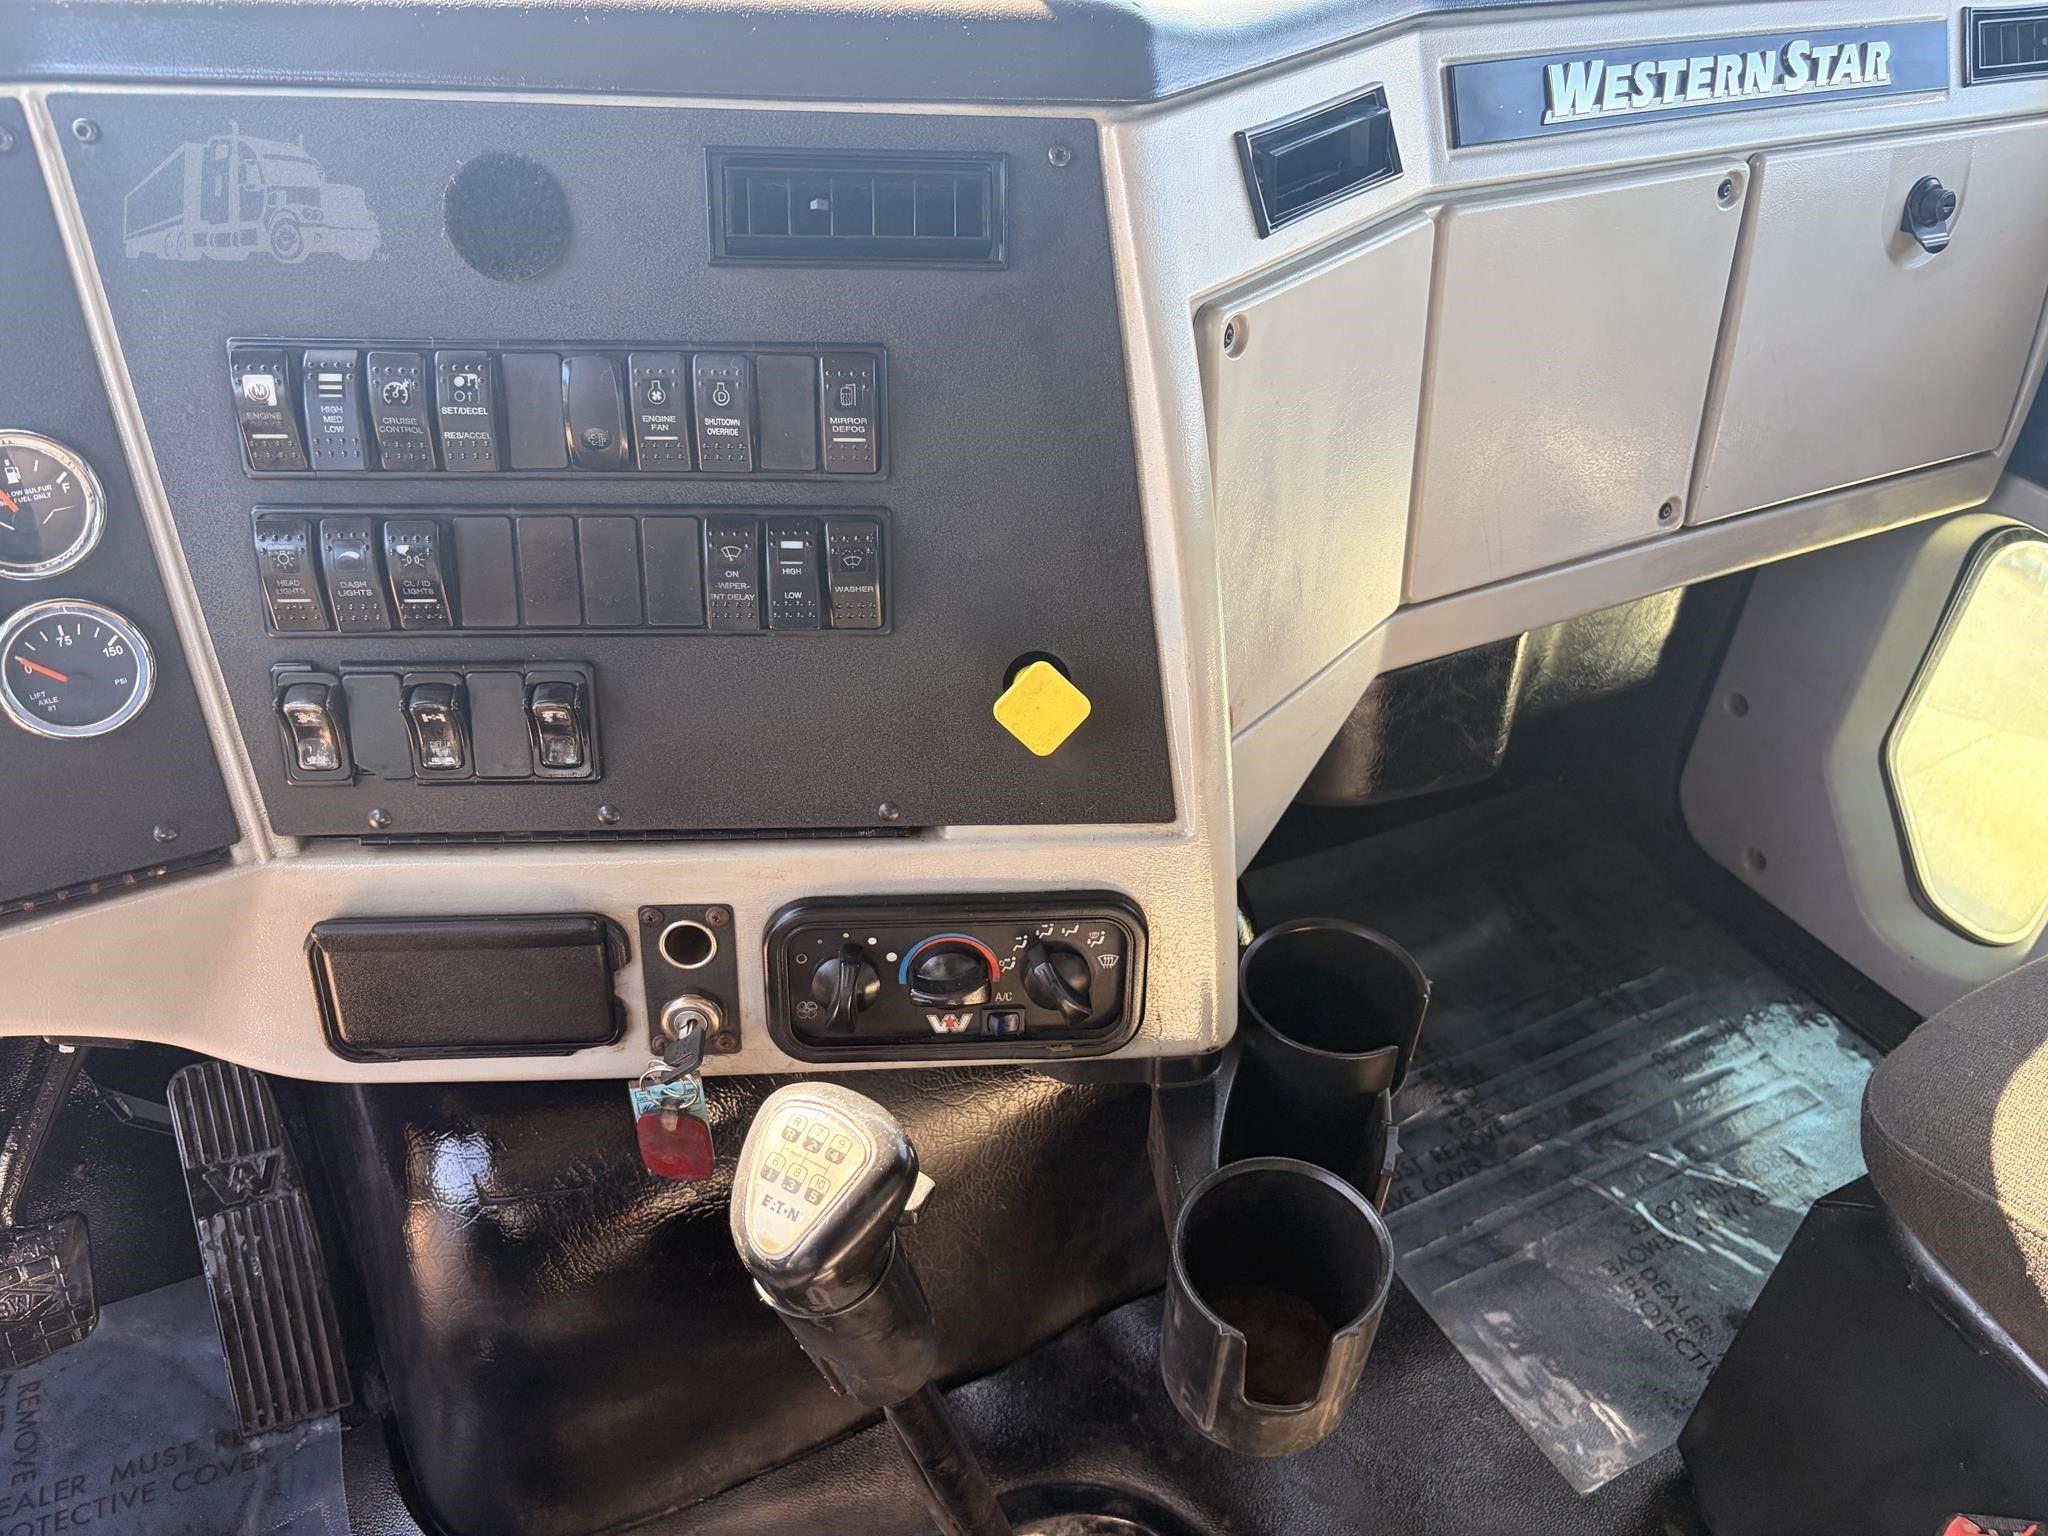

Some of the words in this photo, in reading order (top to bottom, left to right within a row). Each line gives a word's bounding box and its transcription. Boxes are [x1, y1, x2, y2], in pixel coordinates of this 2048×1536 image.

[320, 405, 343, 414] HIGH
[441, 406, 488, 415] SET/DECEL
[246, 411, 283, 420] ENGINE
[323, 415, 343, 424] MED
[642, 415, 677, 423] ENGINE
[382, 417, 417, 425] CRUISE
[704, 417, 740, 427] SHUTDOWN
[829, 417, 868, 425] MIRROR
[324, 425, 345, 434] LOW
[379, 426, 424, 434] CONTROL
[707, 428, 739, 437] OVERRIDE
[444, 431, 491, 440] RES/ACCEL
[6, 489, 23, 498] LOW
[24, 484, 52, 496] SULFUR
[61, 482, 71, 494] F
[14, 496, 33, 504] FUEL
[33, 491, 51, 501] ONLY
[725, 570, 739, 578] ON
[276, 587, 306, 595] LIGHTS
[338, 589, 373, 597] LIGHTS
[56, 635, 73, 648] 75
[102, 645, 124, 658] 150
[24, 664, 33, 674] 0
[114, 678, 128, 687] PSI
[29, 690, 47, 701] LIFT
[38, 696, 59, 706] AXLE
[995, 992, 1013, 1002] A/C
[815, 1127, 824, 1138] 7
[807, 1139, 819, 1151] 2
[837, 1138, 846, 1149] 9
[771, 1156, 780, 1167] 6
[786, 1180, 797, 1192] 3
[814, 1178, 826, 1190] 10
[809, 1189, 818, 1201] 5
[11, 1380, 41, 1486] REMOVE
[0, 1474, 86, 1520] EALER
[110, 1440, 199, 1485] MUST
[5, 1481, 156, 1536] OTECTIVE
[171, 1452, 271, 1494] COVER
